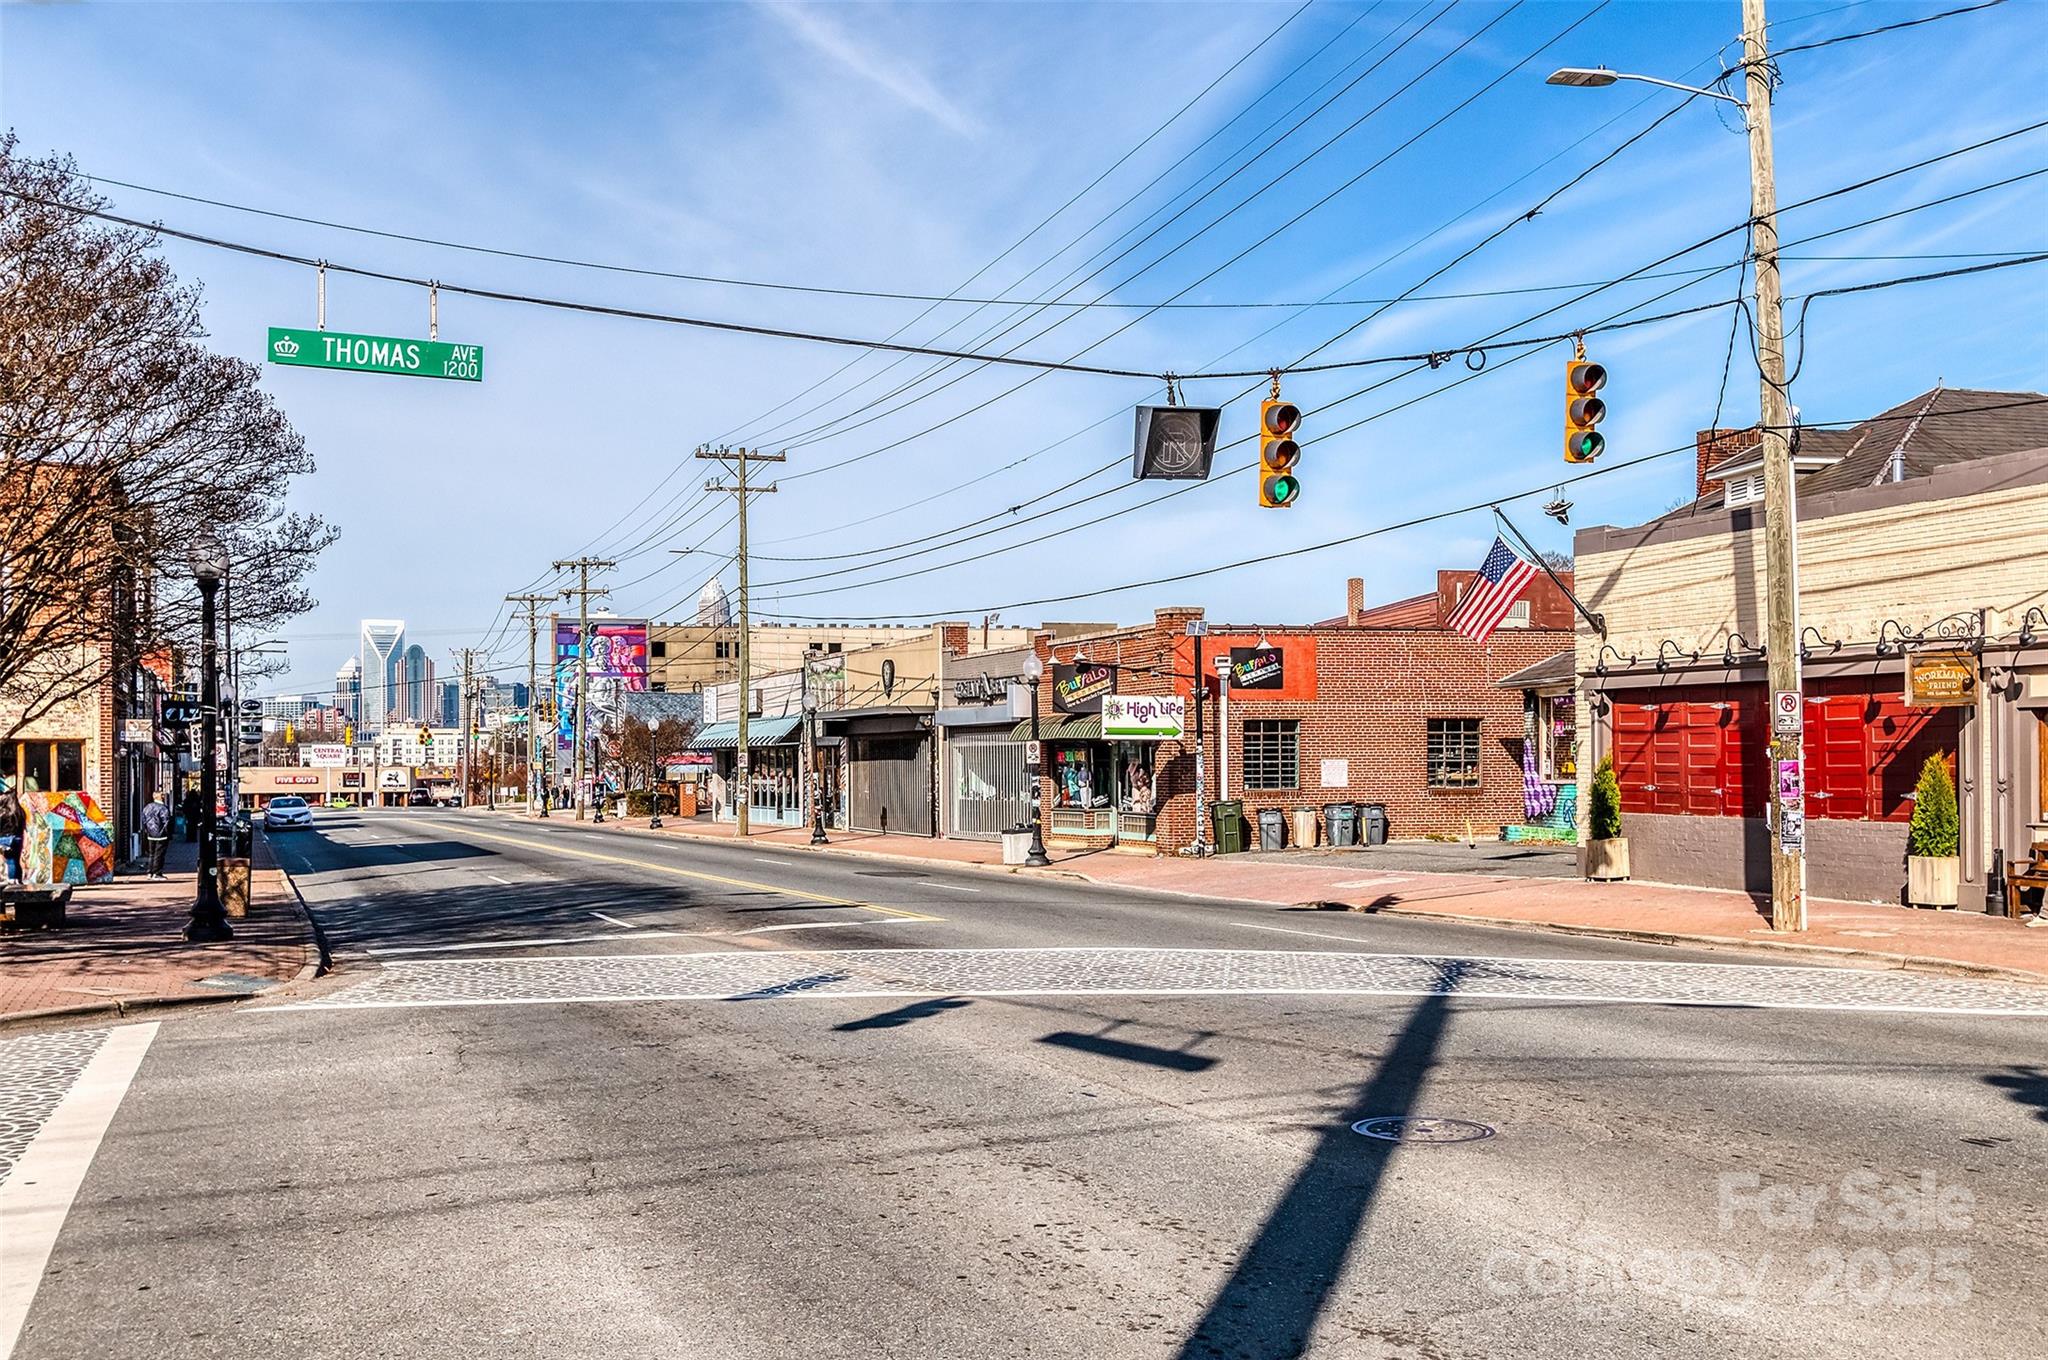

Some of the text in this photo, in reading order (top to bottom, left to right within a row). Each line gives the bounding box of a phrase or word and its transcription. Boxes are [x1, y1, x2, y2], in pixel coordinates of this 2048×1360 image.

[322, 337, 420, 369] THOMAS
[451, 345, 478, 362] AVE
[443, 360, 478, 378] 1200
[1914, 669, 1971, 684] WORKMAN'S
[1929, 681, 1958, 689] FRIEND
[1126, 702, 1157, 723] High
[295, 776, 317, 784] GUYS
